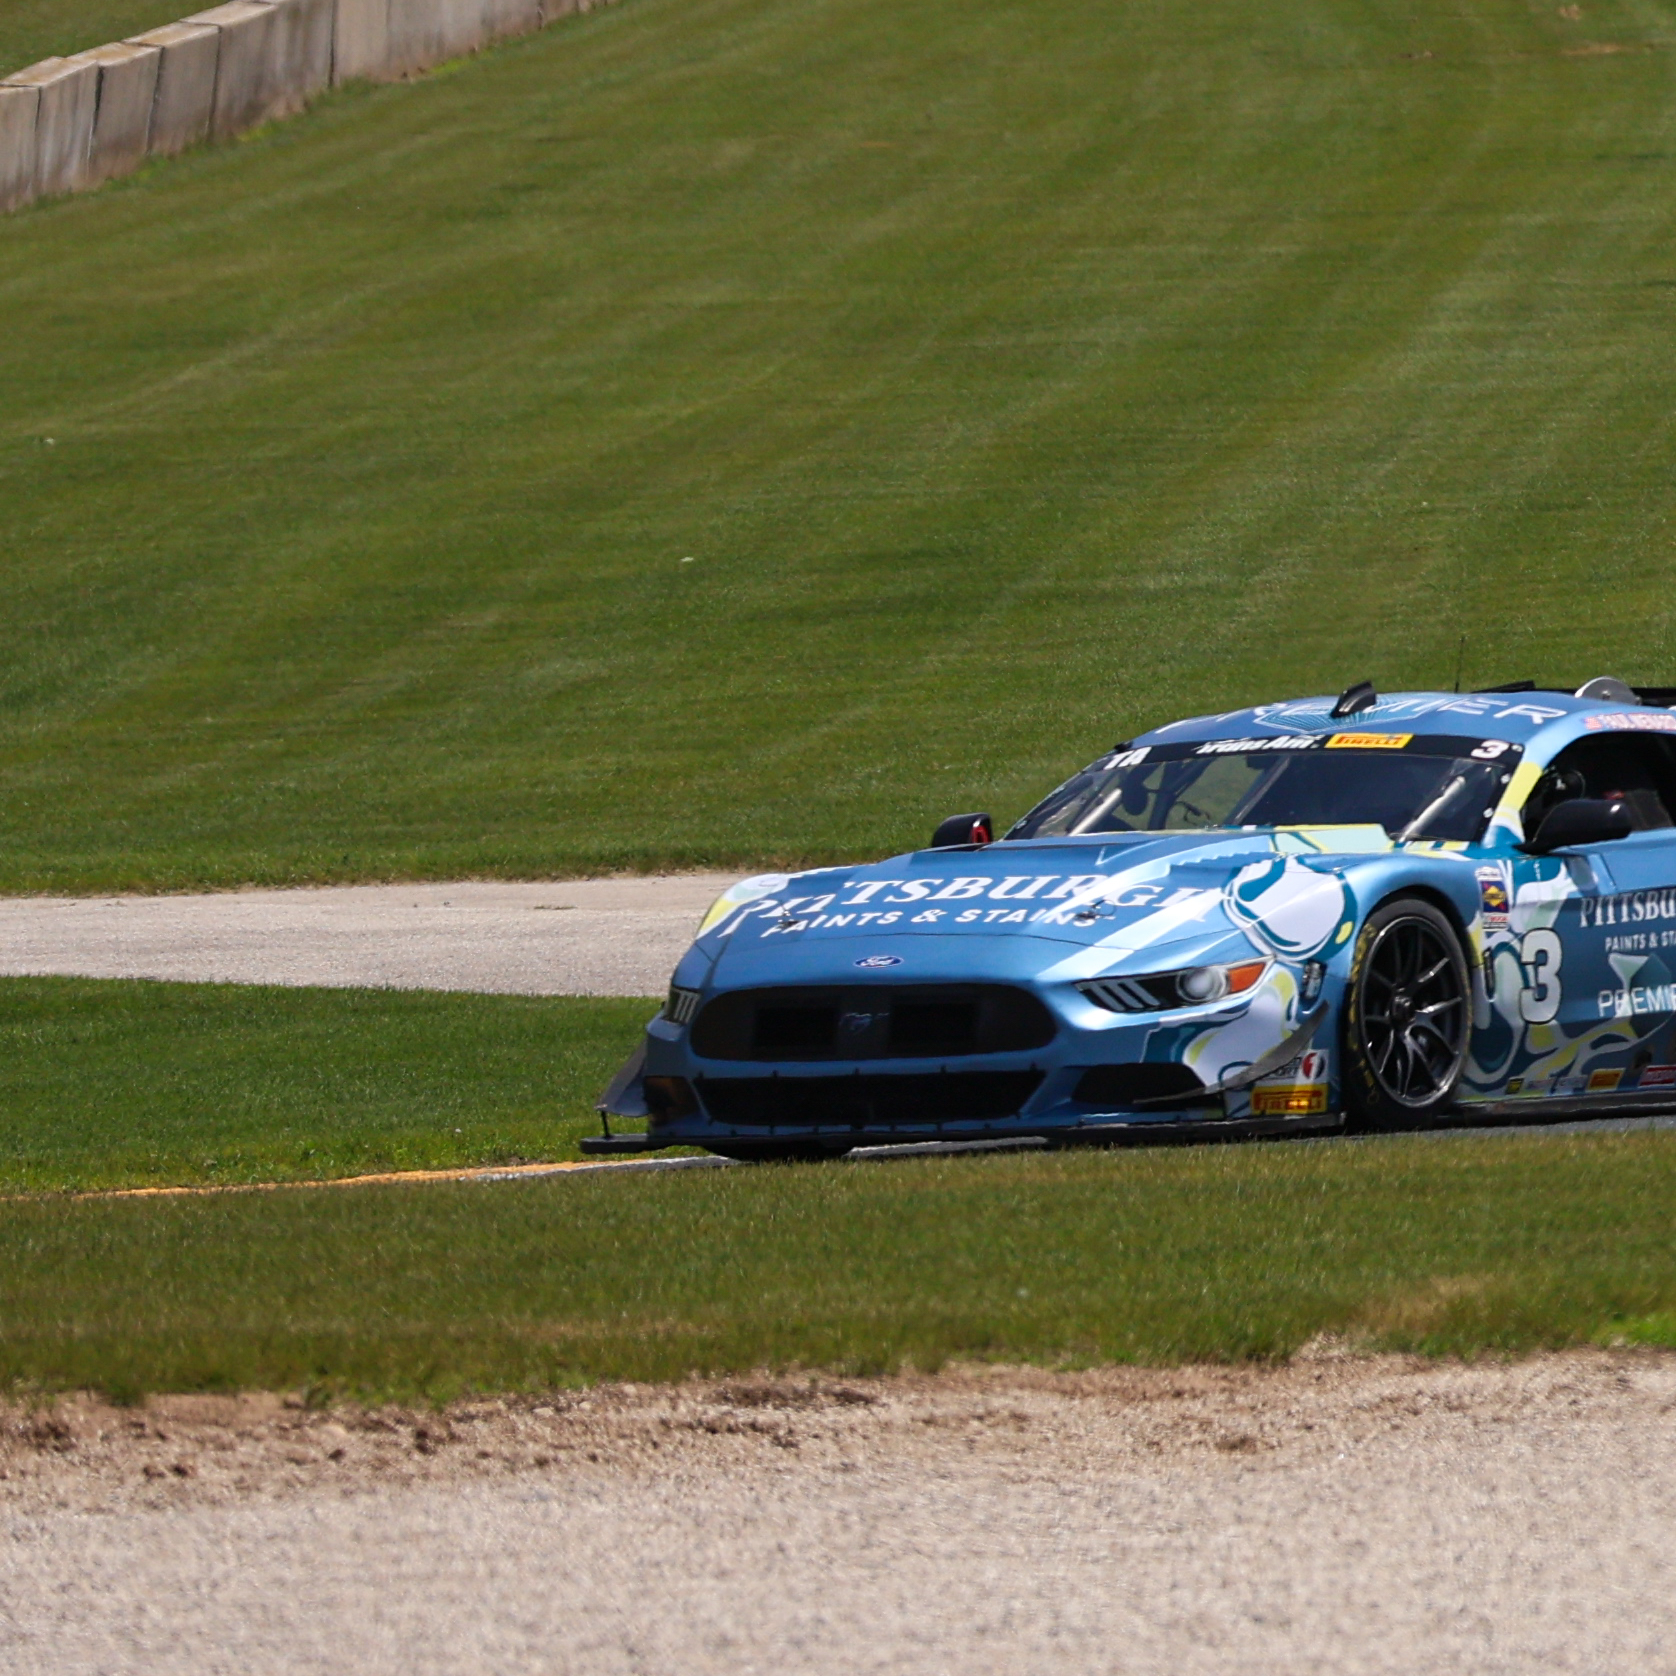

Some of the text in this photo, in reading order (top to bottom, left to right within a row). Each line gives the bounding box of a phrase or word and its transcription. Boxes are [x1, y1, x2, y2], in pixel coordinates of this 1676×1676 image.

[1333, 736, 1407, 749] PIRELLI
[1471, 740, 1510, 759] 3
[1104, 746, 1153, 771] TA
[760, 910, 903, 938] PAINTS
[911, 908, 947, 924] &
[1605, 935, 1646, 951] PAINTS
[1649, 932, 1658, 946] &
[1518, 927, 1563, 1024] 3
[1254, 1090, 1323, 1111] PIRELLI
